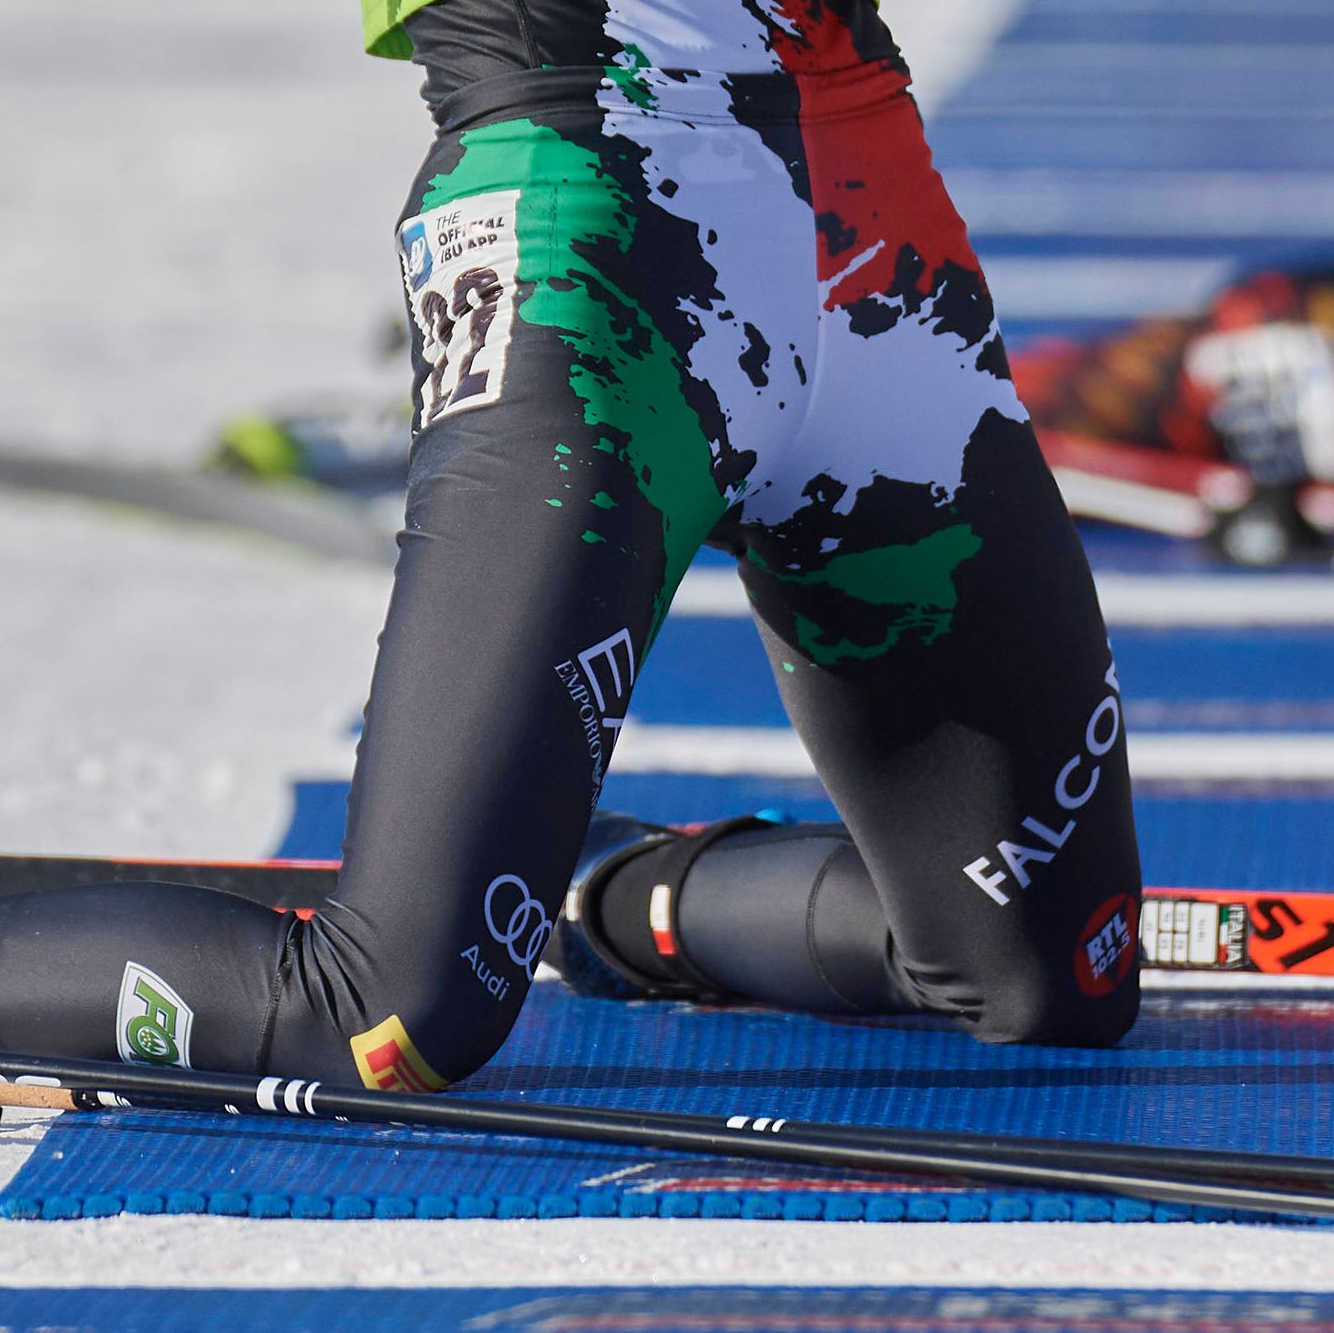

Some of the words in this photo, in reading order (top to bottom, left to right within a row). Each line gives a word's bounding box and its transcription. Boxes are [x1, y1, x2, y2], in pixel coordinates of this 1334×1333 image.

[435, 210, 463, 231] THE
[553, 658, 603, 760] EMPORIO
[962, 659, 1120, 907] FALCO
[1086, 912, 1128, 966] RTL
[1091, 930, 1131, 981] 102.5
[1227, 905, 1245, 965] ITALIA
[459, 944, 511, 1002] Audi
